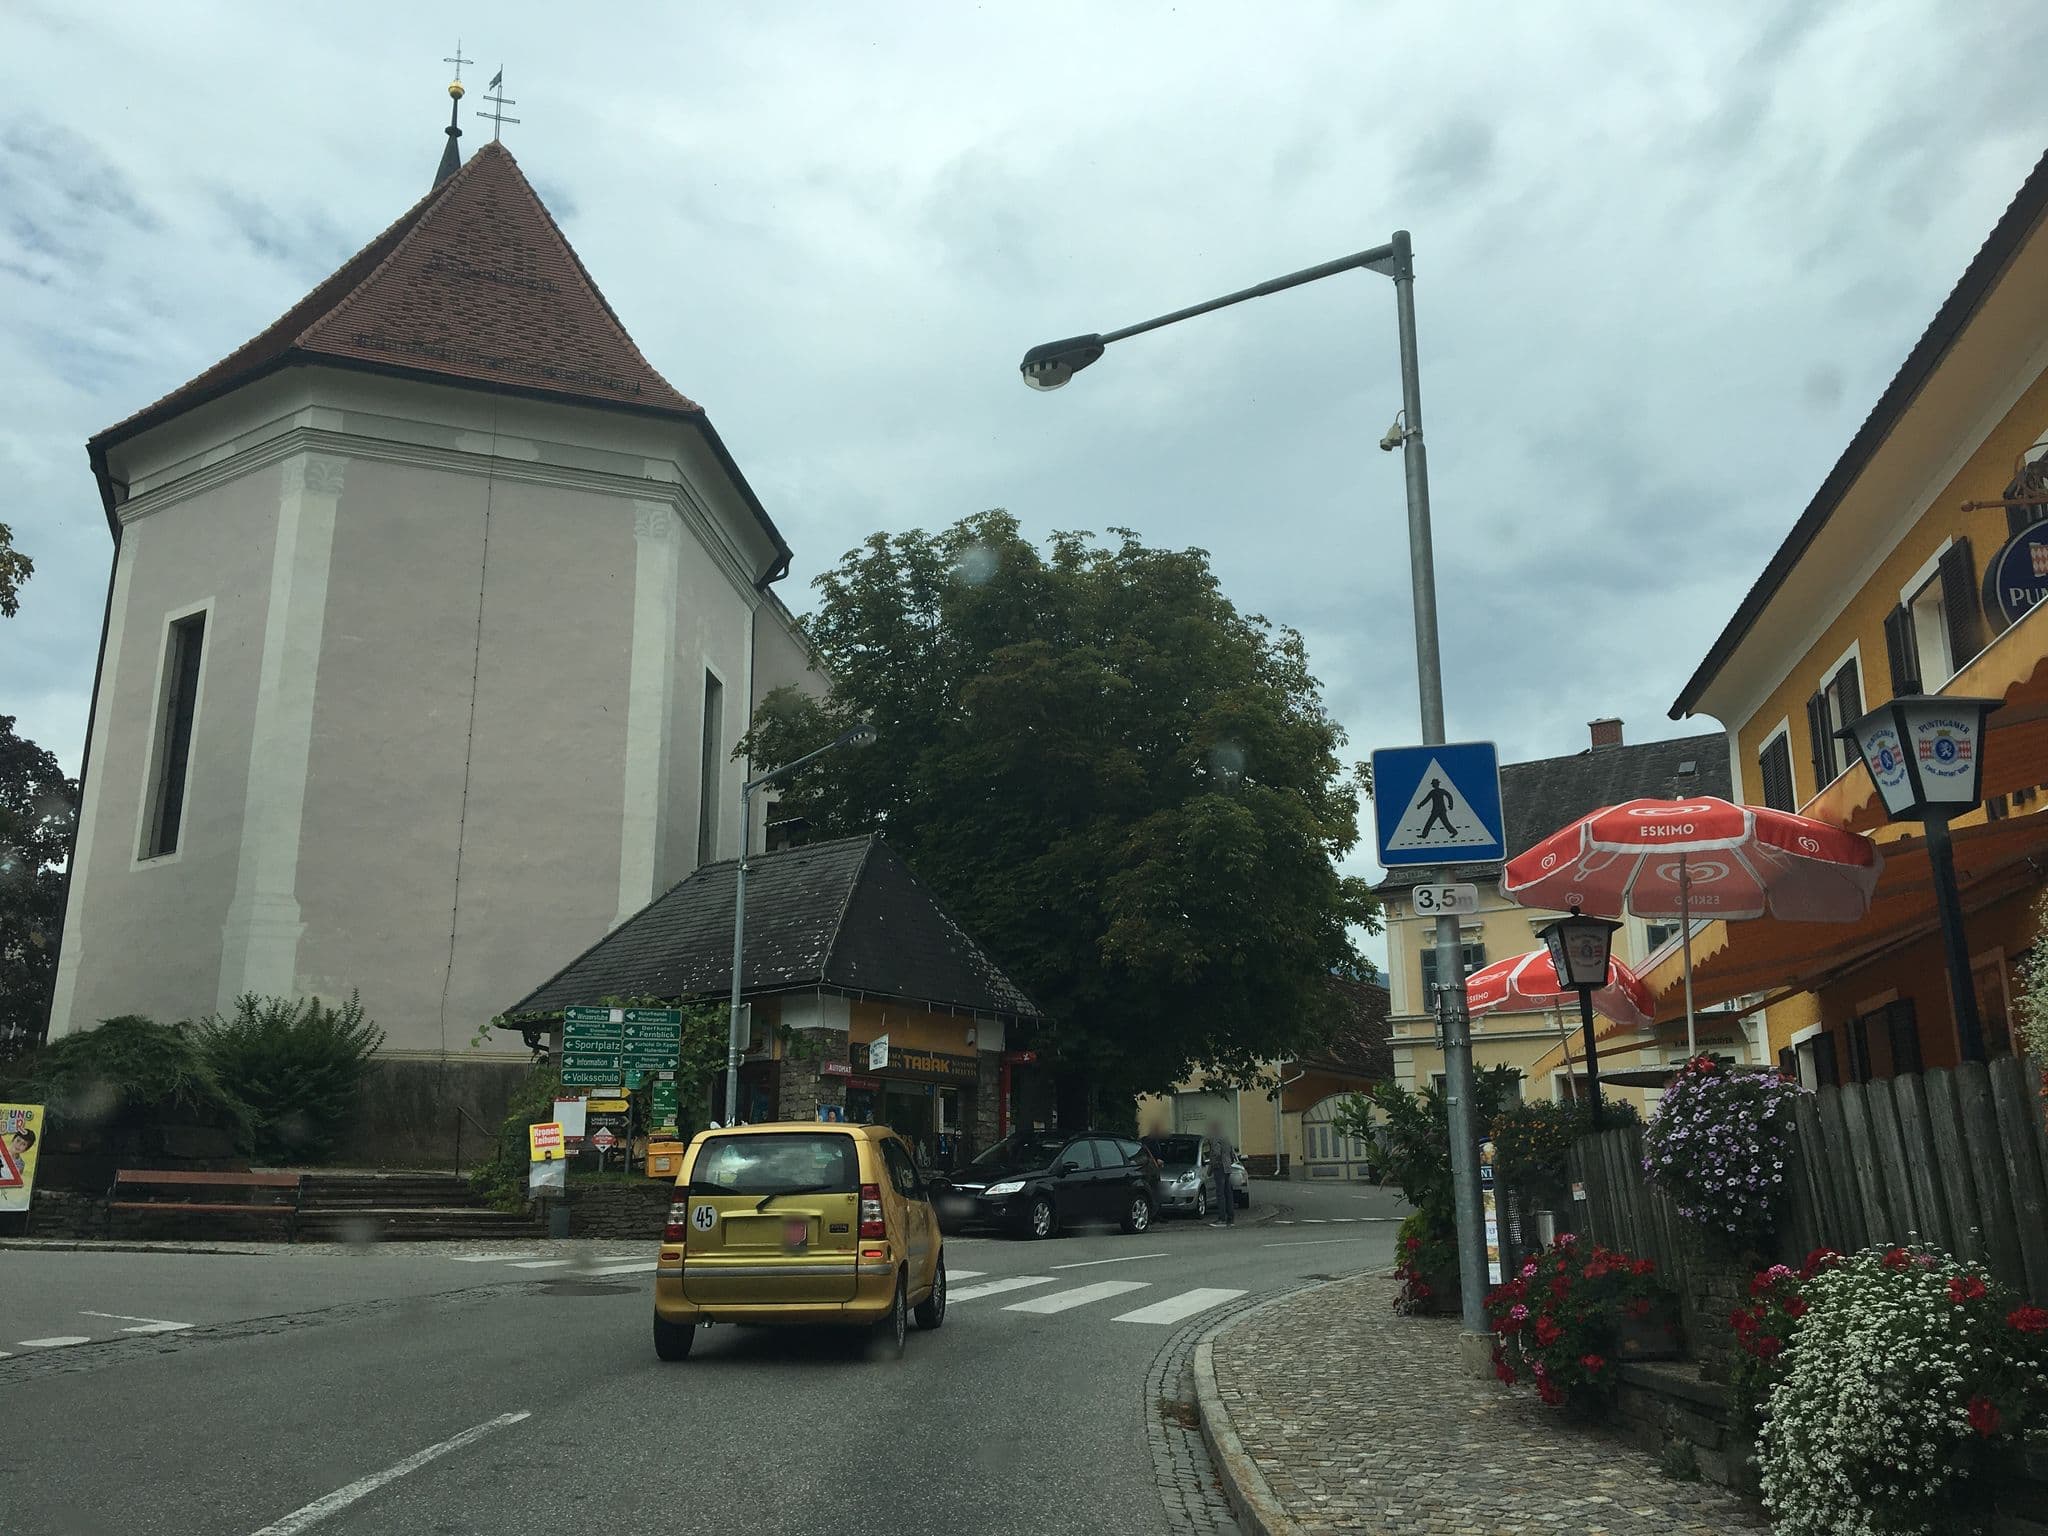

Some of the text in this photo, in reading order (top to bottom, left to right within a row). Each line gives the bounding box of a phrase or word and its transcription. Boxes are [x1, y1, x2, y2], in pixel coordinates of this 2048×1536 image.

[1918, 720, 1970, 734] PUNTIGAMER
[1641, 823, 1695, 837] ESKIMO
[574, 1040, 621, 1051] Sportplatz
[576, 1057, 608, 1066] Information
[903, 1054, 950, 1073] TABAK
[829, 1063, 852, 1073] AUTOMAT
[572, 1073, 619, 1082] Volksschule
[534, 1127, 560, 1137] Kronen
[697, 1206, 714, 1229] 45
